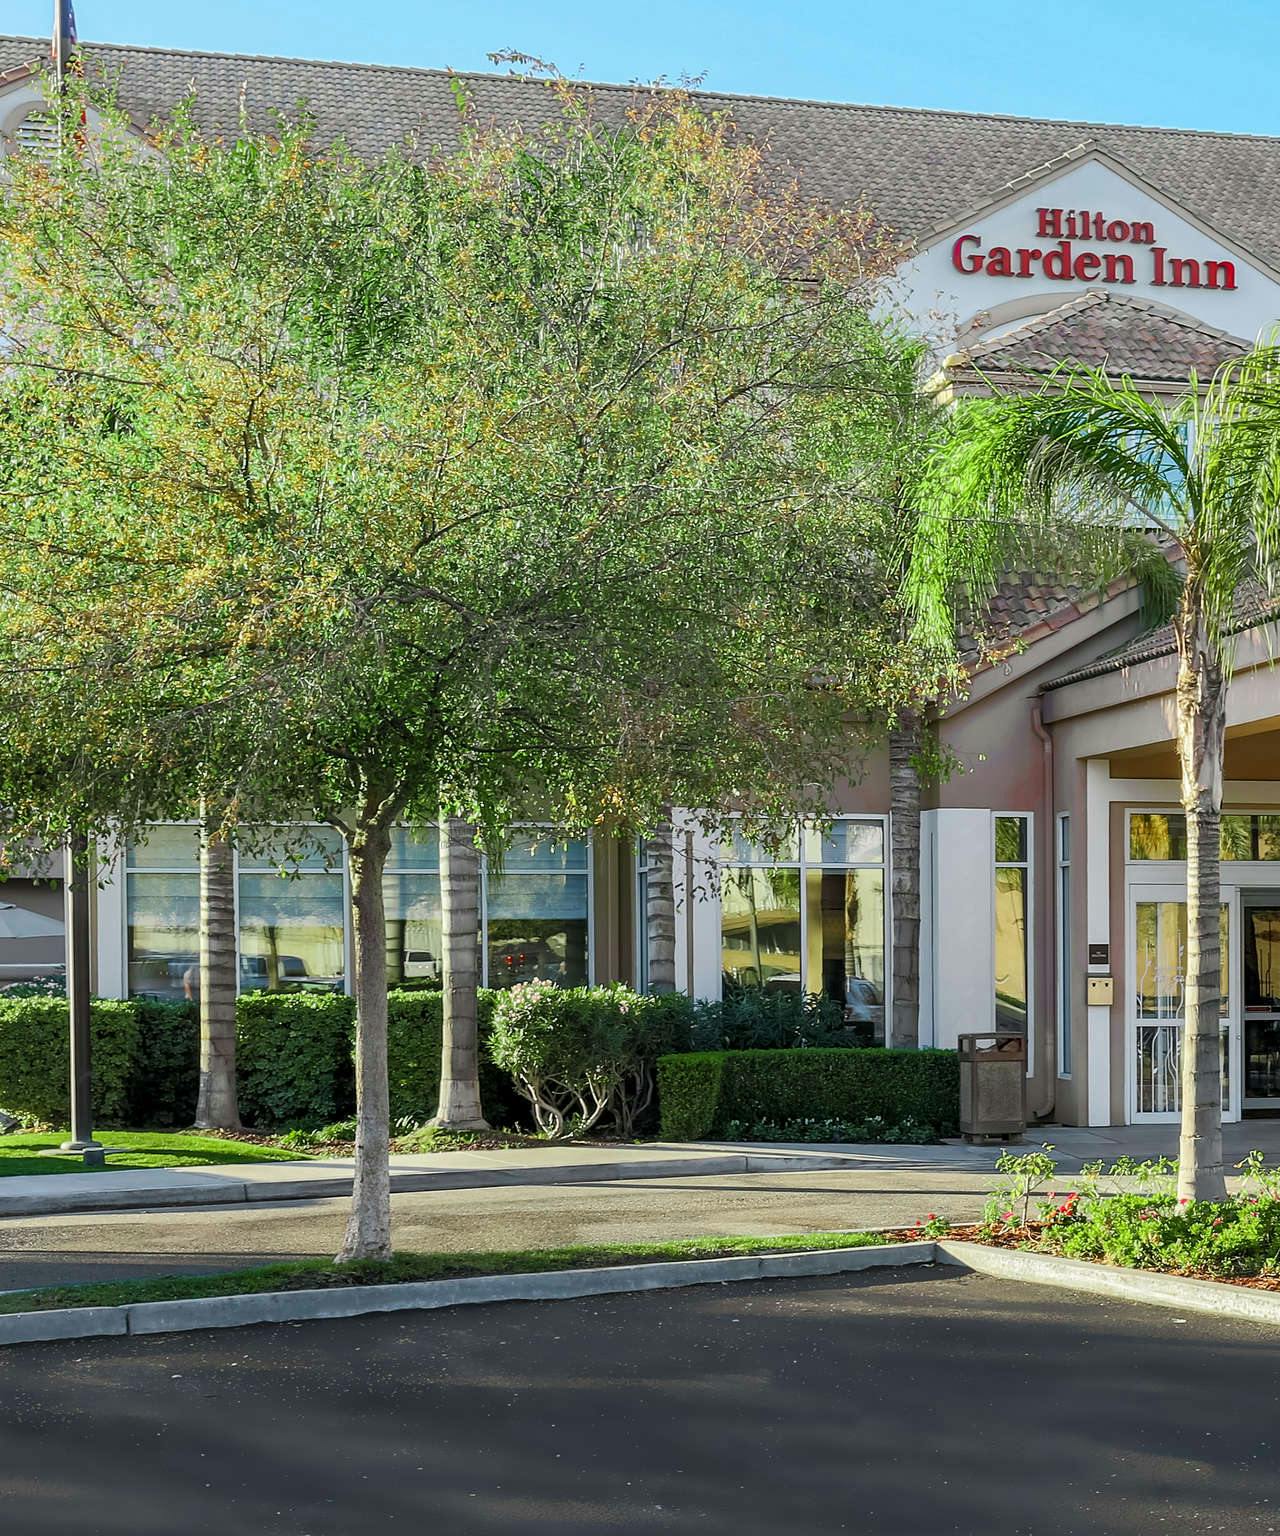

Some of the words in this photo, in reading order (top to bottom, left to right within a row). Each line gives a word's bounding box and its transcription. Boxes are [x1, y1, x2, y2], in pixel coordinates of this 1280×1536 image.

[1036, 207, 1156, 244] Hilton
[952, 234, 1136, 284] Garden
[1150, 247, 1238, 290] Inn
